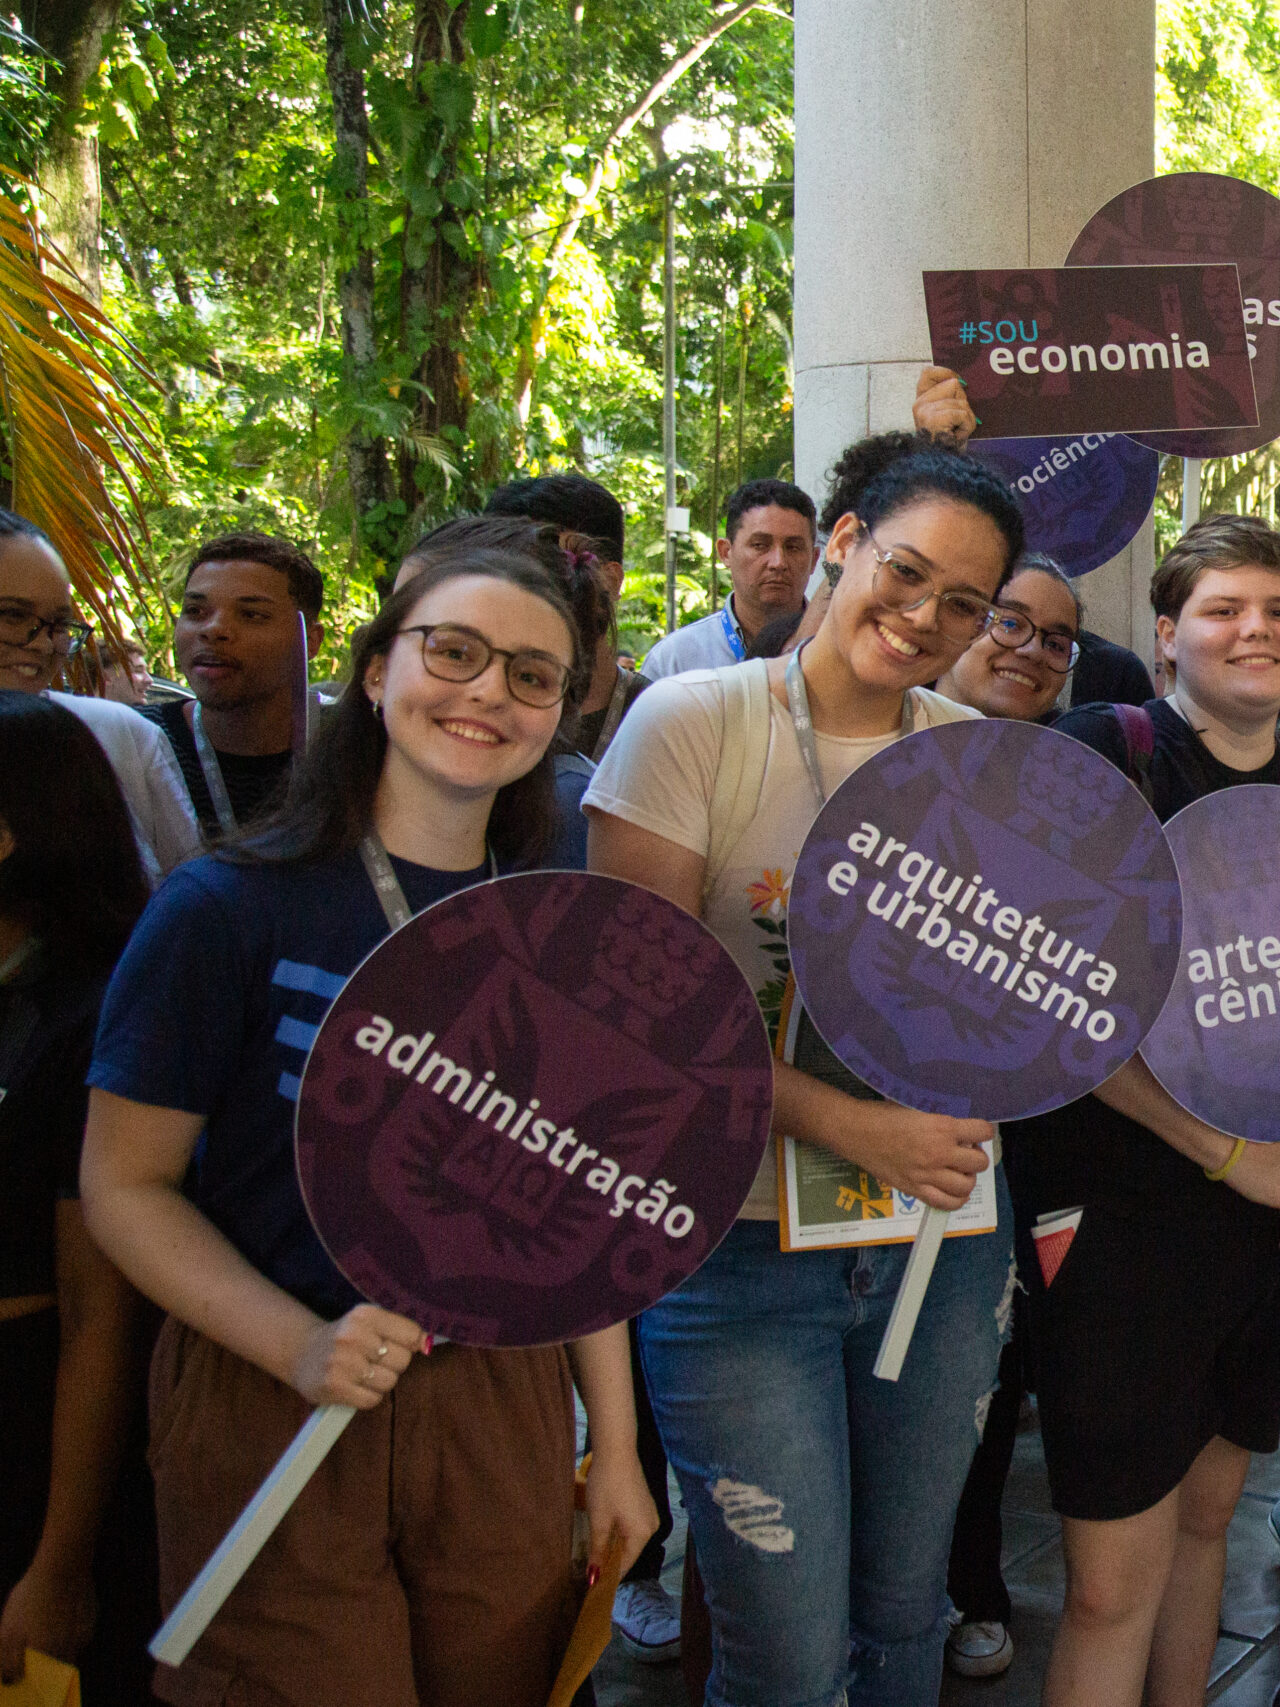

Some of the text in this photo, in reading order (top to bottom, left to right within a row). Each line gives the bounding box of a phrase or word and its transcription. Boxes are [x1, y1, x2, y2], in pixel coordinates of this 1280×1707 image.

[959, 320, 1038, 344] #SOU
[989, 332, 1210, 375] economia
[827, 860, 1116, 1042] e urbanismo
[847, 821, 1118, 997] arquitetura
[355, 1014, 696, 1240] administração
